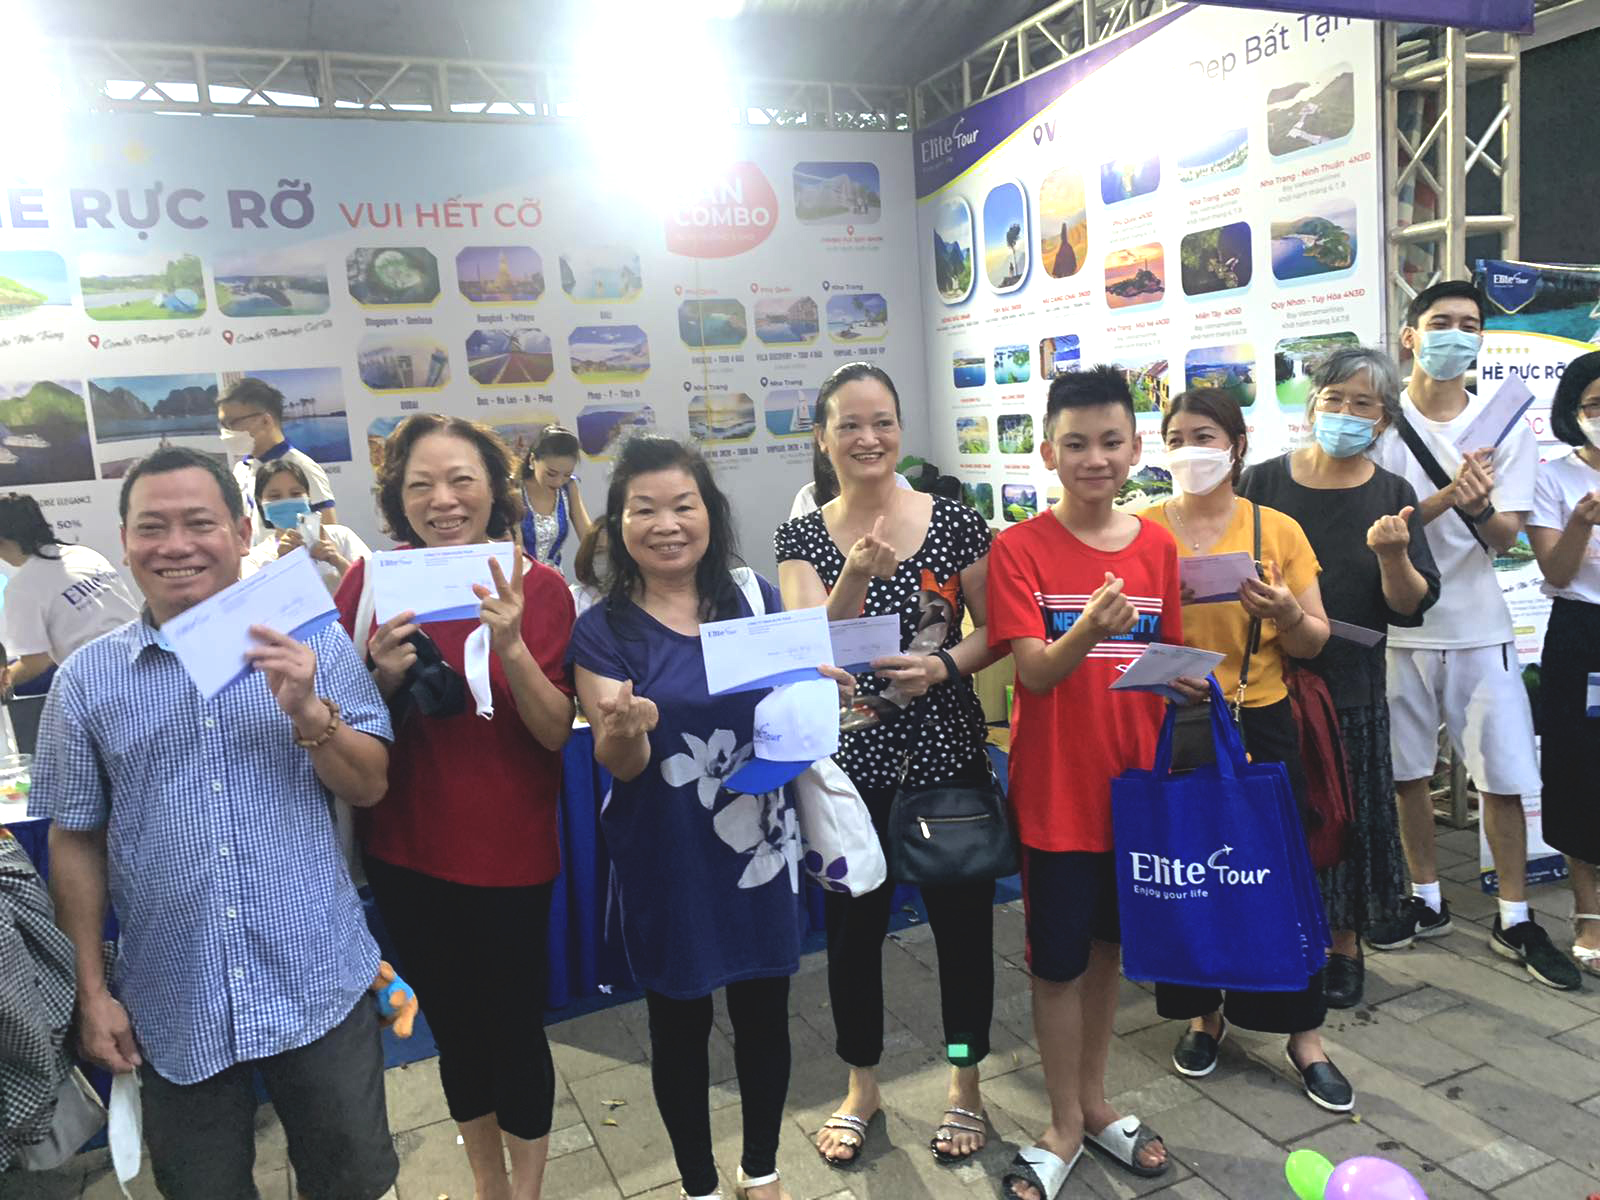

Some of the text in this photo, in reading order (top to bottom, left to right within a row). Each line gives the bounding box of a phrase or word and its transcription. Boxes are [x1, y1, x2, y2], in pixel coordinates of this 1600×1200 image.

[1246, 22, 1290, 65] Bất
[920, 129, 979, 164] Elite Tour
[1275, 174, 1297, 183] Trang
[1301, 167, 1320, 176] Ninh
[70, 180, 209, 240] RỰC
[226, 178, 314, 229] RỠ
[338, 194, 543, 228] VUI HẾT CỠ
[674, 206, 770, 227] COMBO
[1270, 301, 1285, 310] Quy
[1312, 295, 1325, 304] Tuy
[1343, 288, 1366, 298] 4N3D
[102, 339, 132, 350] Combo
[236, 333, 264, 344] Combo
[1482, 362, 1504, 380] HÈ
[784, 378, 802, 387] Trang
[56, 519, 82, 530] 50%
[1131, 613, 1160, 633] ITY
[1129, 851, 1271, 886] Elite Tour
[1133, 884, 1209, 900] Enjoy your life
